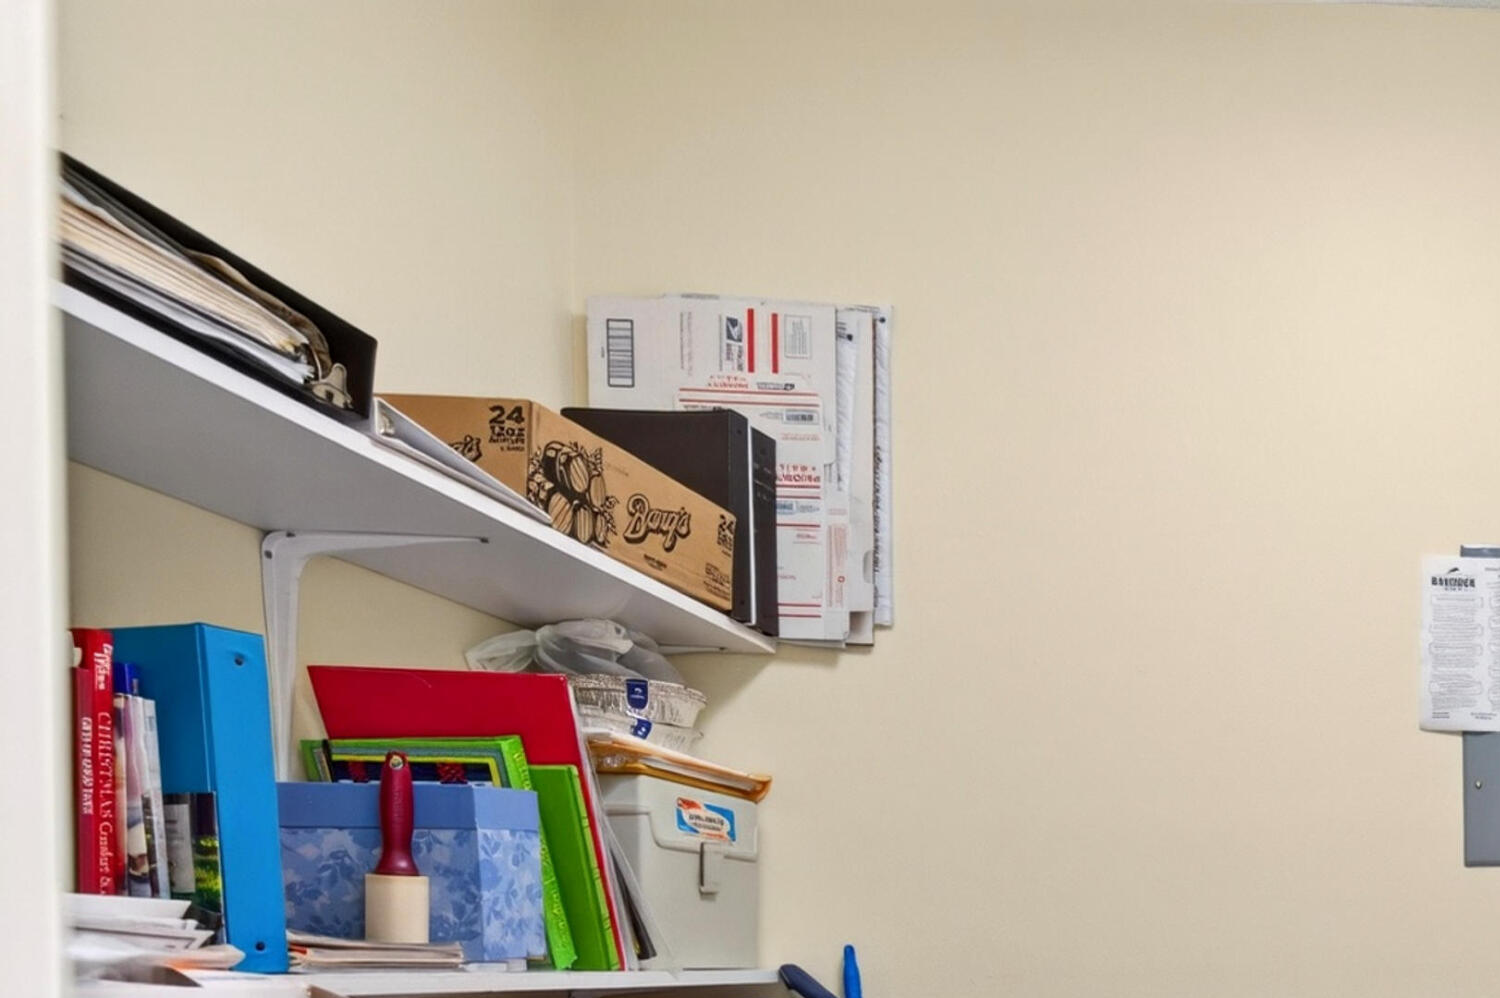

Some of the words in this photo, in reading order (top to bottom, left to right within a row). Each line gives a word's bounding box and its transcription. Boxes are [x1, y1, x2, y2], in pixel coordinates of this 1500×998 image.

[488, 404, 526, 425] 24
[622, 492, 692, 554] Barq's
[97, 712, 114, 819] CHRISTMAS
